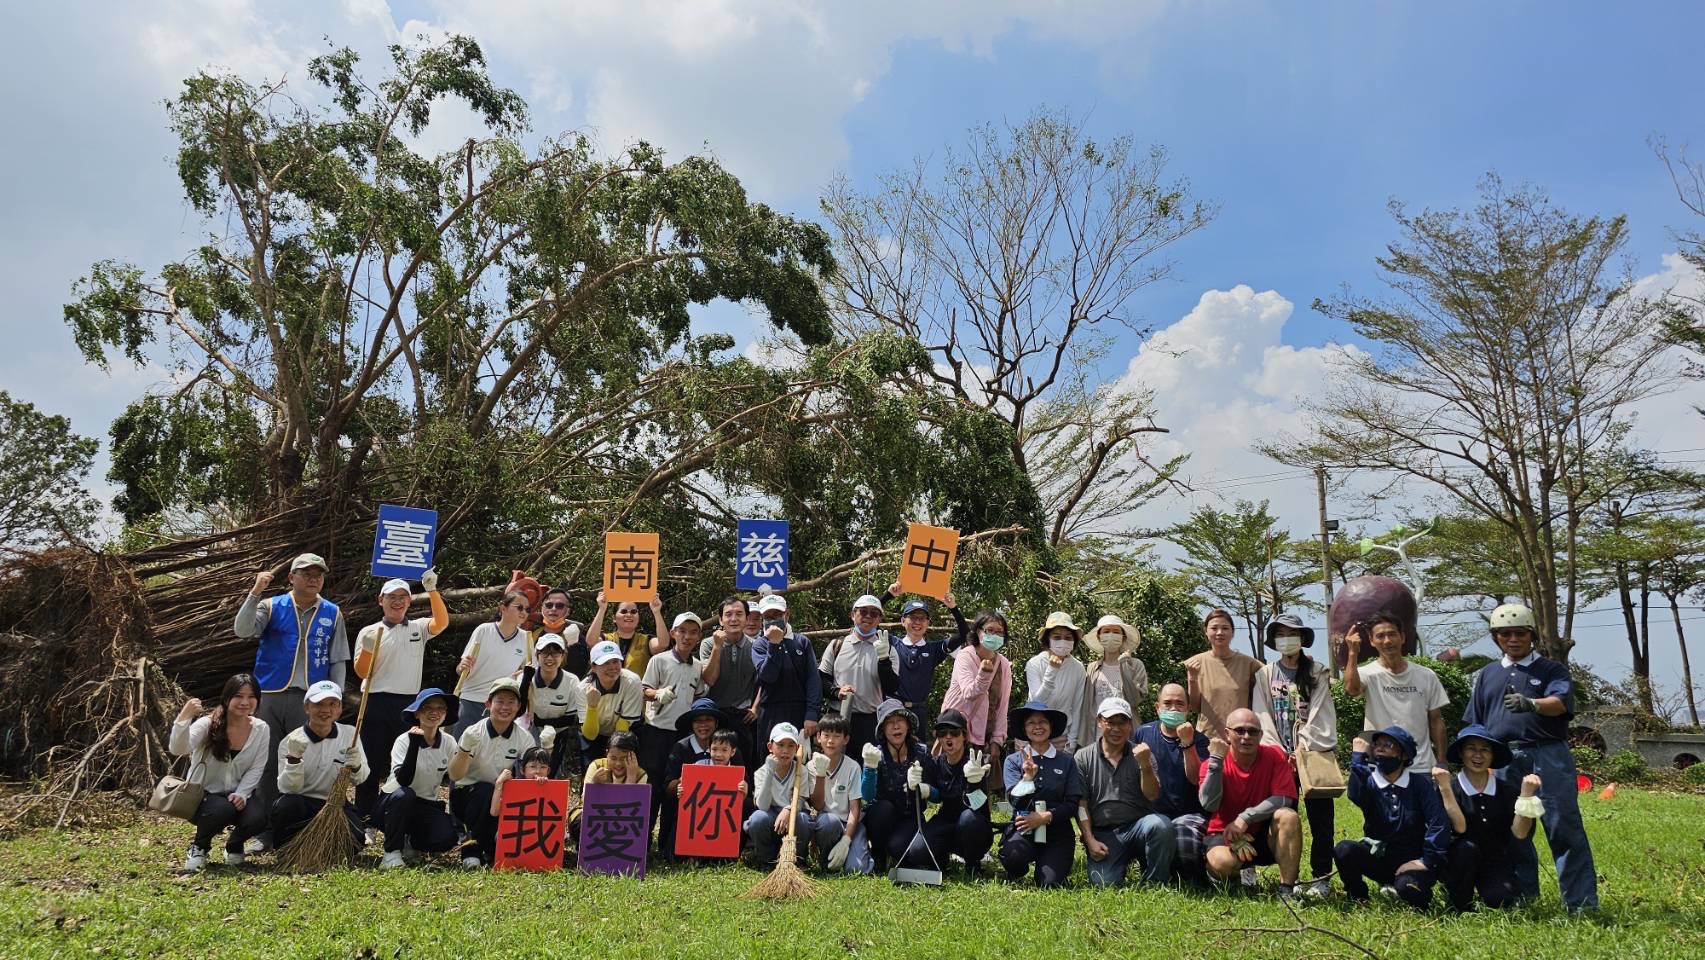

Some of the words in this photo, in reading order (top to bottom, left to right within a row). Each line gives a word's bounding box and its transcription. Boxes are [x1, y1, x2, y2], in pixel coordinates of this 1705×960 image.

[377, 520, 432, 568] 臺
[609, 546, 655, 589] 南
[740, 532, 785, 577] 慈
[908, 539, 950, 582] 中
[502, 797, 562, 858] 我
[583, 801, 644, 862] 愛
[683, 781, 737, 840] 你
